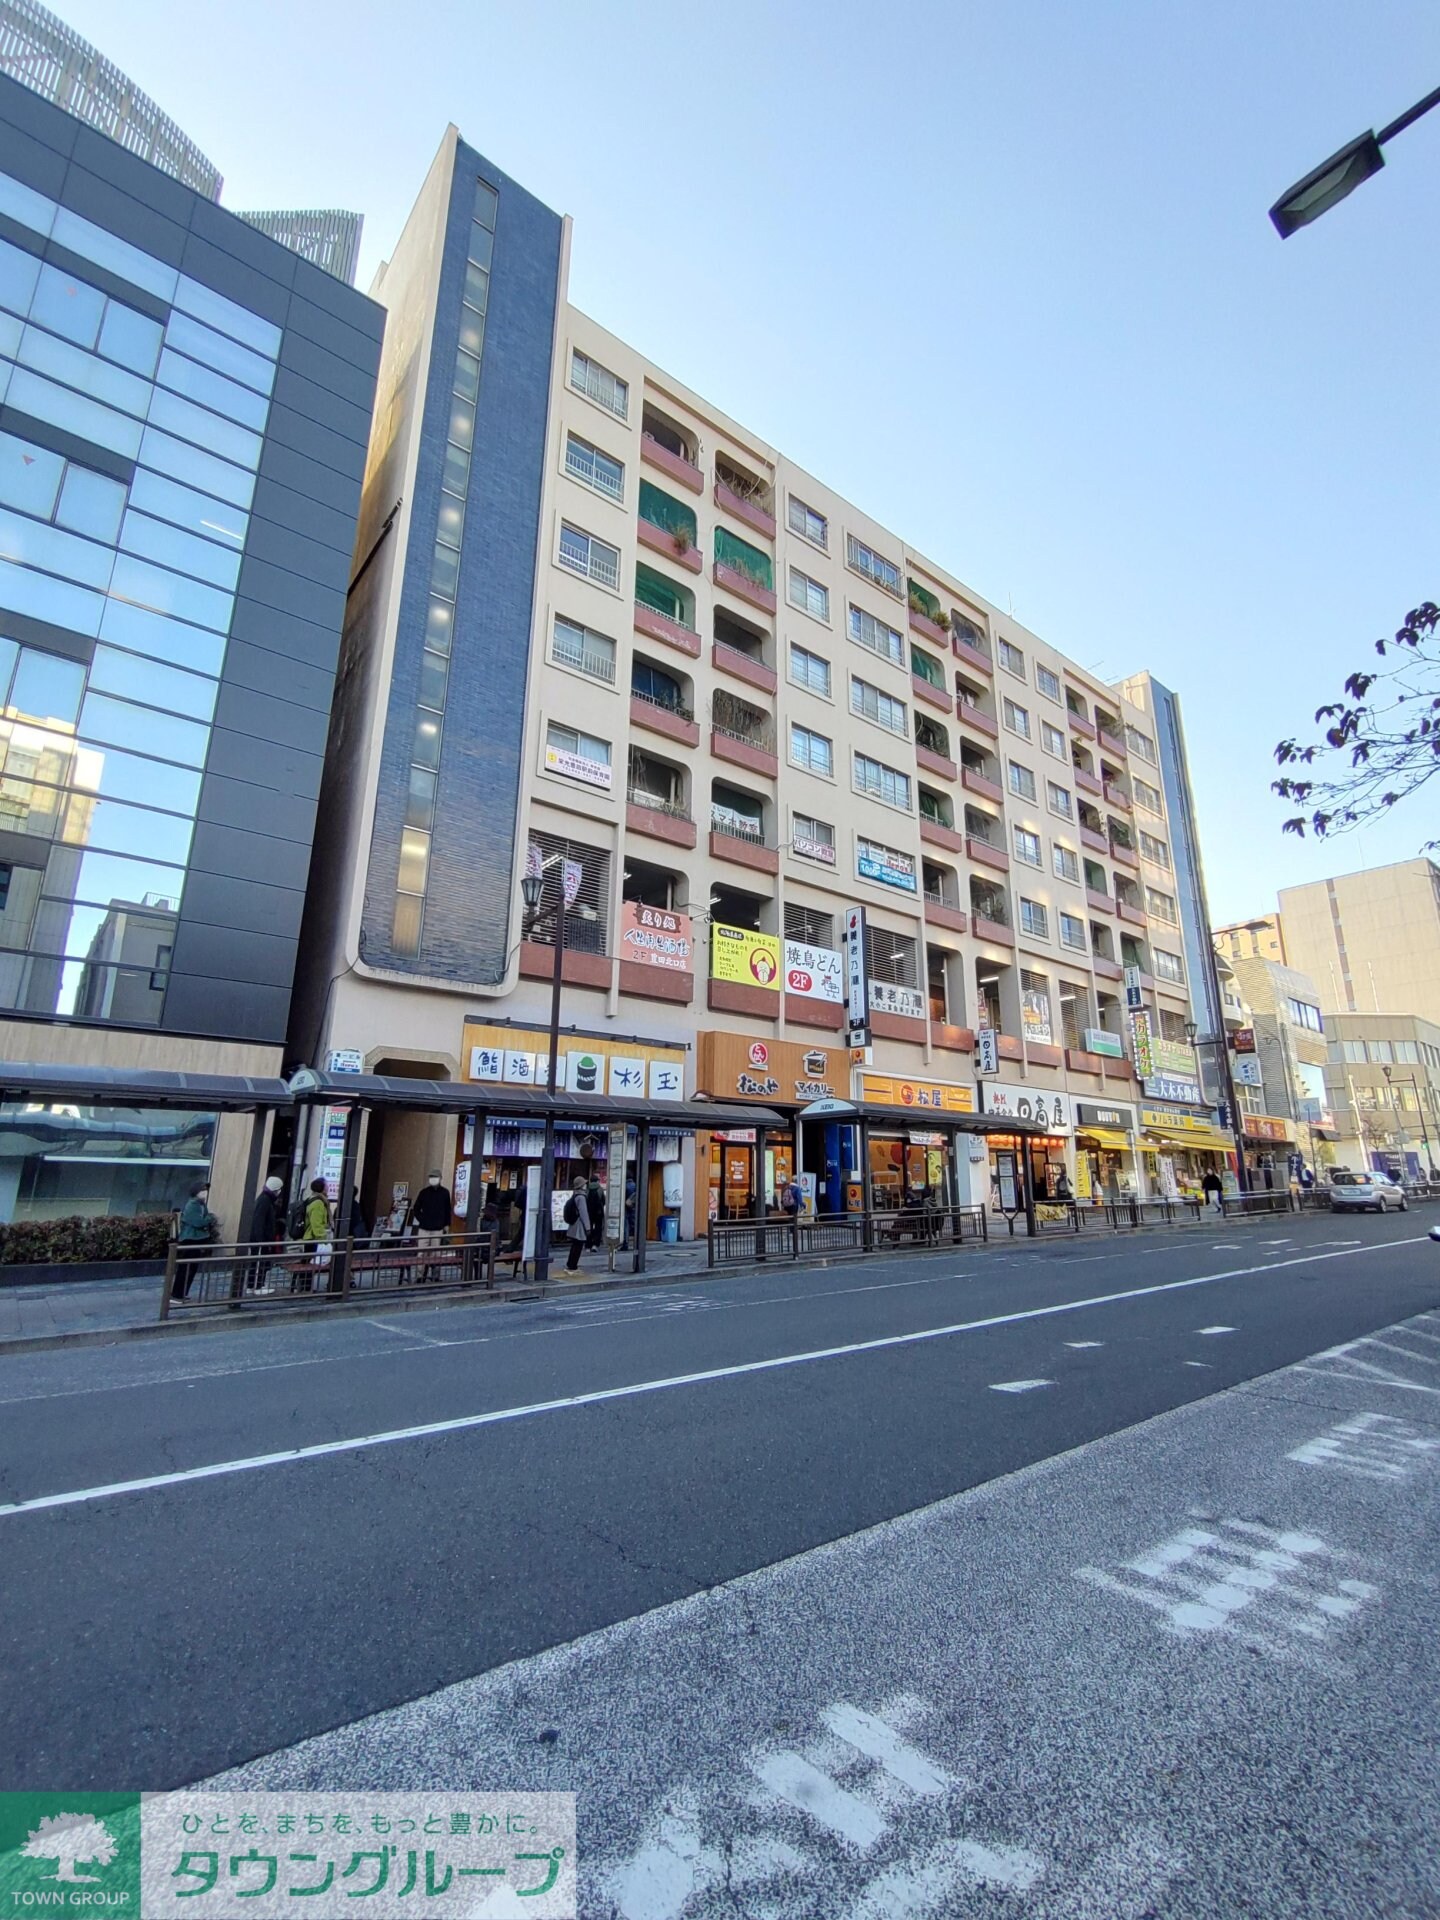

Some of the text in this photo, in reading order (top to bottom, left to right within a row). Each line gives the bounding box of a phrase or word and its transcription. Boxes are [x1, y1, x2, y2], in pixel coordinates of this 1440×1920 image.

[633, 949, 648, 960] 2F
[786, 946, 841, 975] 焼鳥どん
[792, 972, 808, 989] 2F
[874, 985, 923, 1009] 養老乃瀧
[737, 1073, 779, 1095] 松のや
[1159, 1080, 1200, 1101] 大木不動産
[918, 1087, 942, 1107] 松屋
[1017, 1095, 1068, 1131] 日高屋
